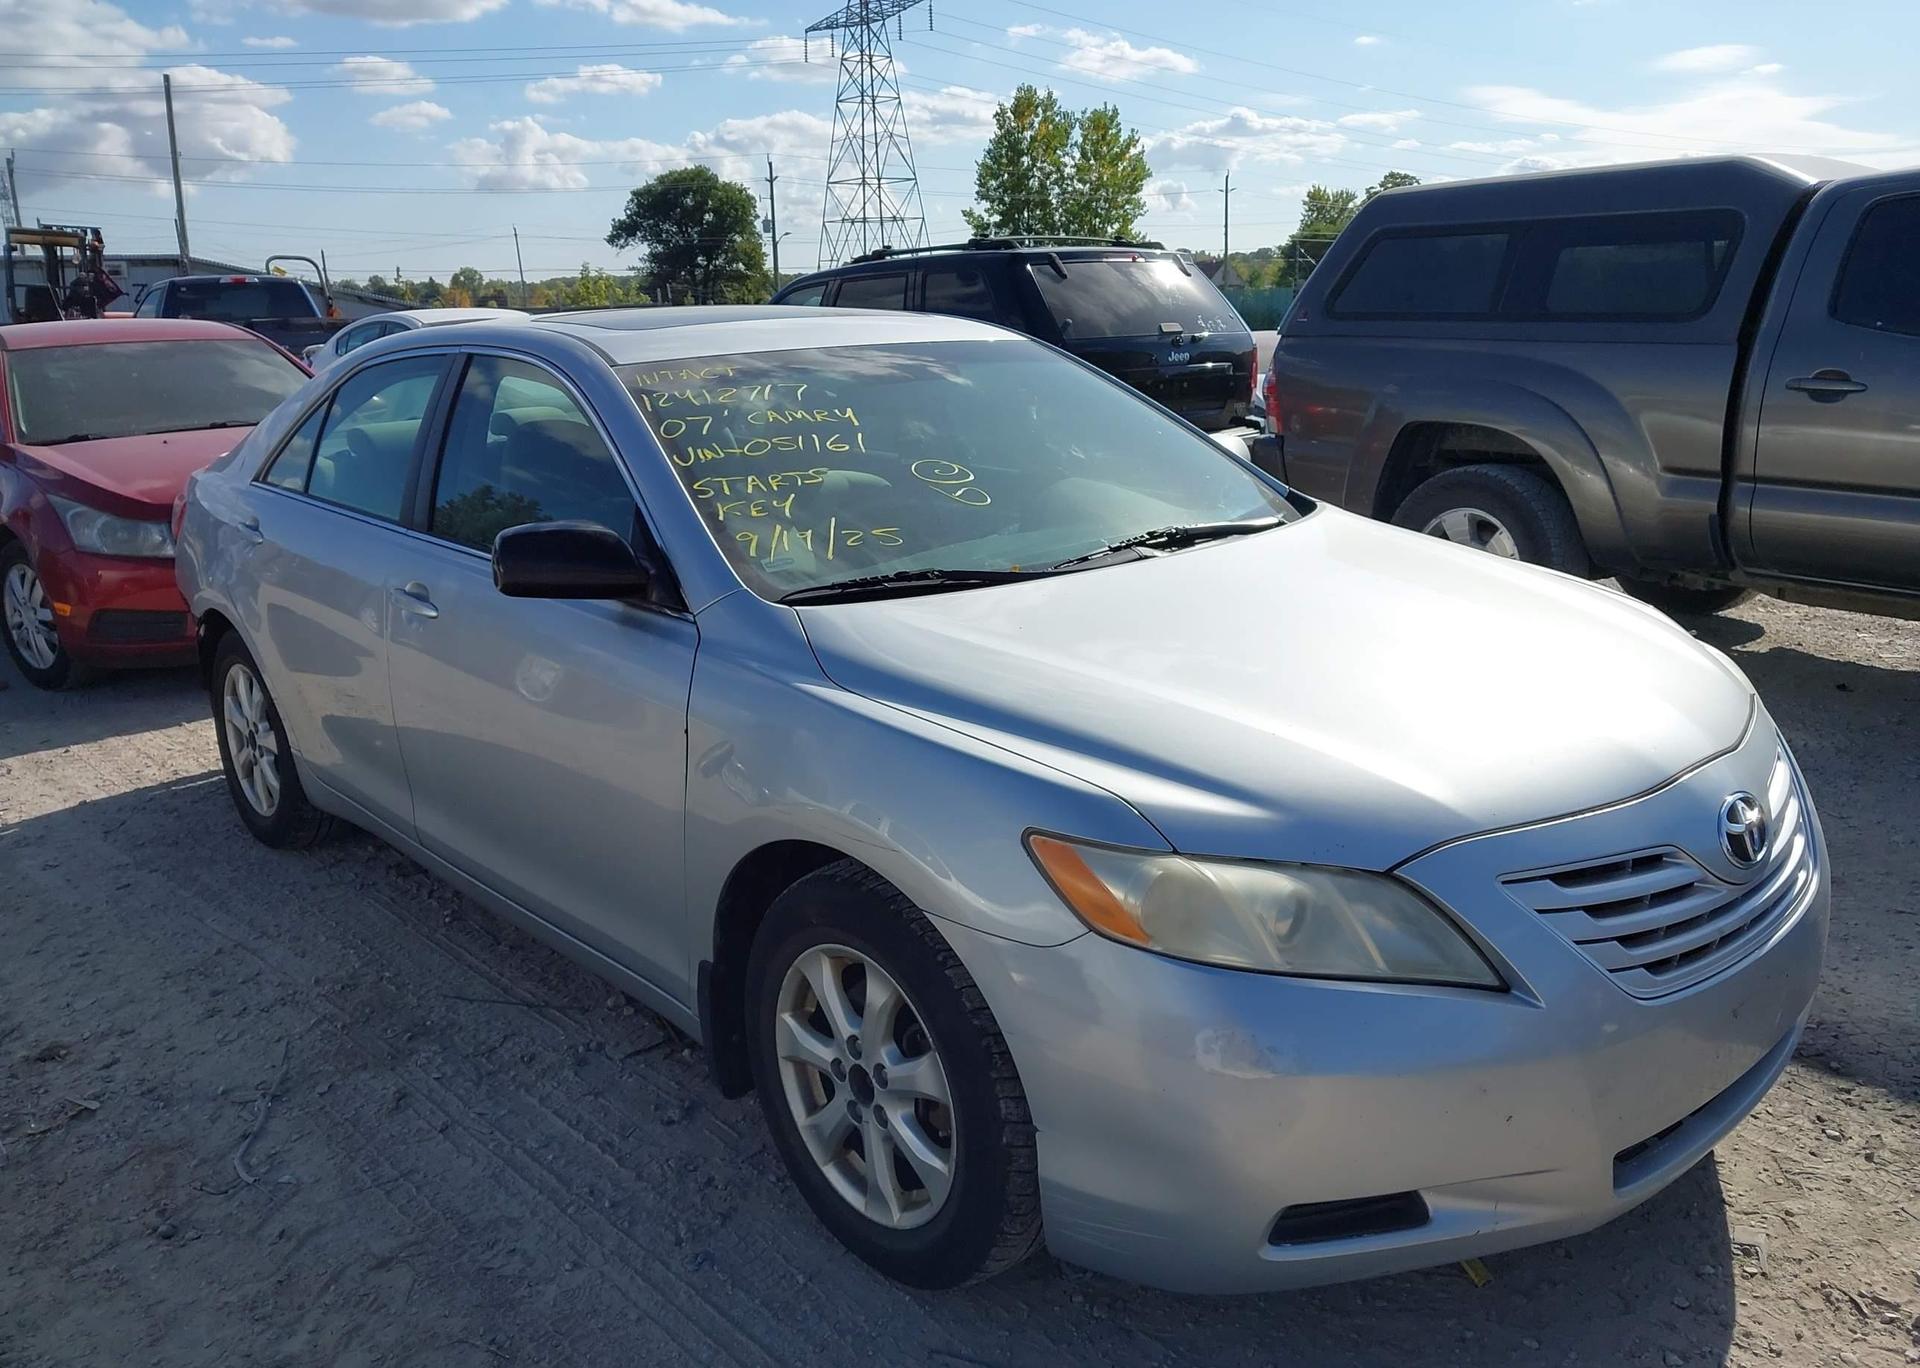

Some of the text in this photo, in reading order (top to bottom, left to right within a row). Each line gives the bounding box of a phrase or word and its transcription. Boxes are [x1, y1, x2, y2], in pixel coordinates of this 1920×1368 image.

[1168, 351, 1190, 362] Jeep
[636, 366, 737, 387] INTACT
[747, 405, 861, 427] CAMRY
[692, 467, 830, 499] STARTS
[715, 493, 796, 521] KEY
